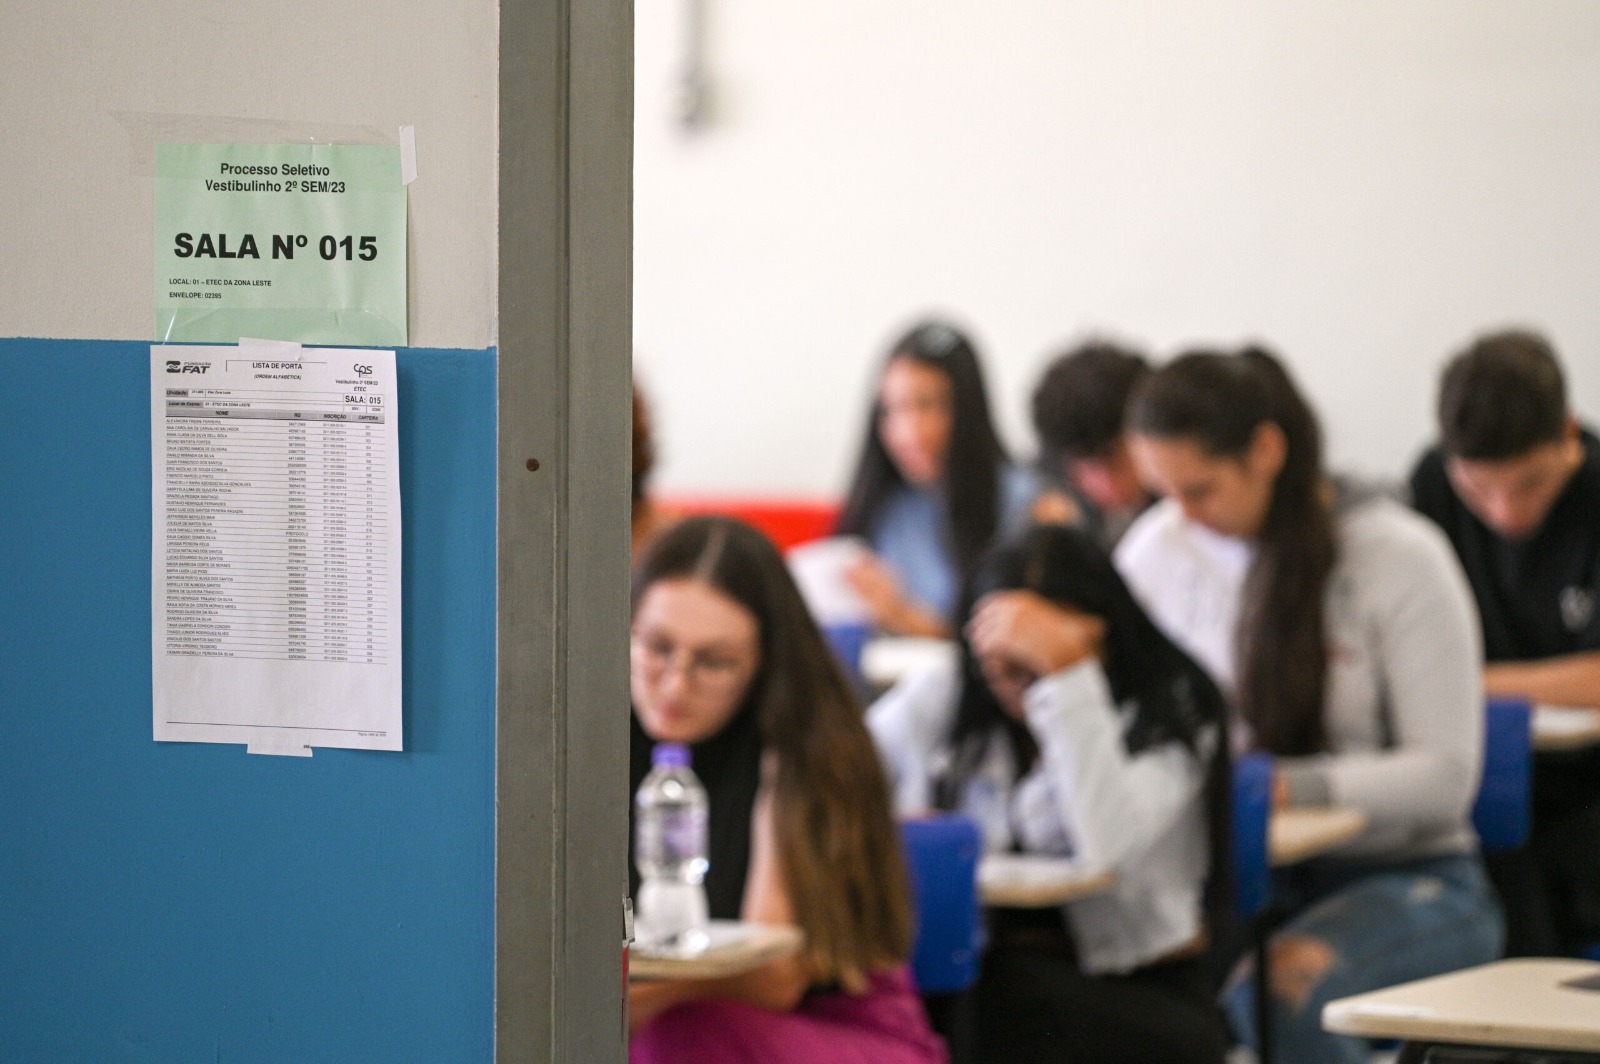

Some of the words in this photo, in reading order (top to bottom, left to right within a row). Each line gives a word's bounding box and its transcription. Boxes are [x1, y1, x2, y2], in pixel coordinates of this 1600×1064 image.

[220, 163, 278, 175] Processo
[281, 164, 330, 176] Seletivo
[205, 180, 281, 192] Vestibulinho
[285, 181, 297, 192] 2º
[301, 181, 346, 193] SEM/23
[174, 233, 260, 259] SALA
[272, 234, 308, 260] Nº
[319, 235, 378, 261] 015
[182, 365, 210, 374] FAT
[345, 395, 366, 403] SALA:
